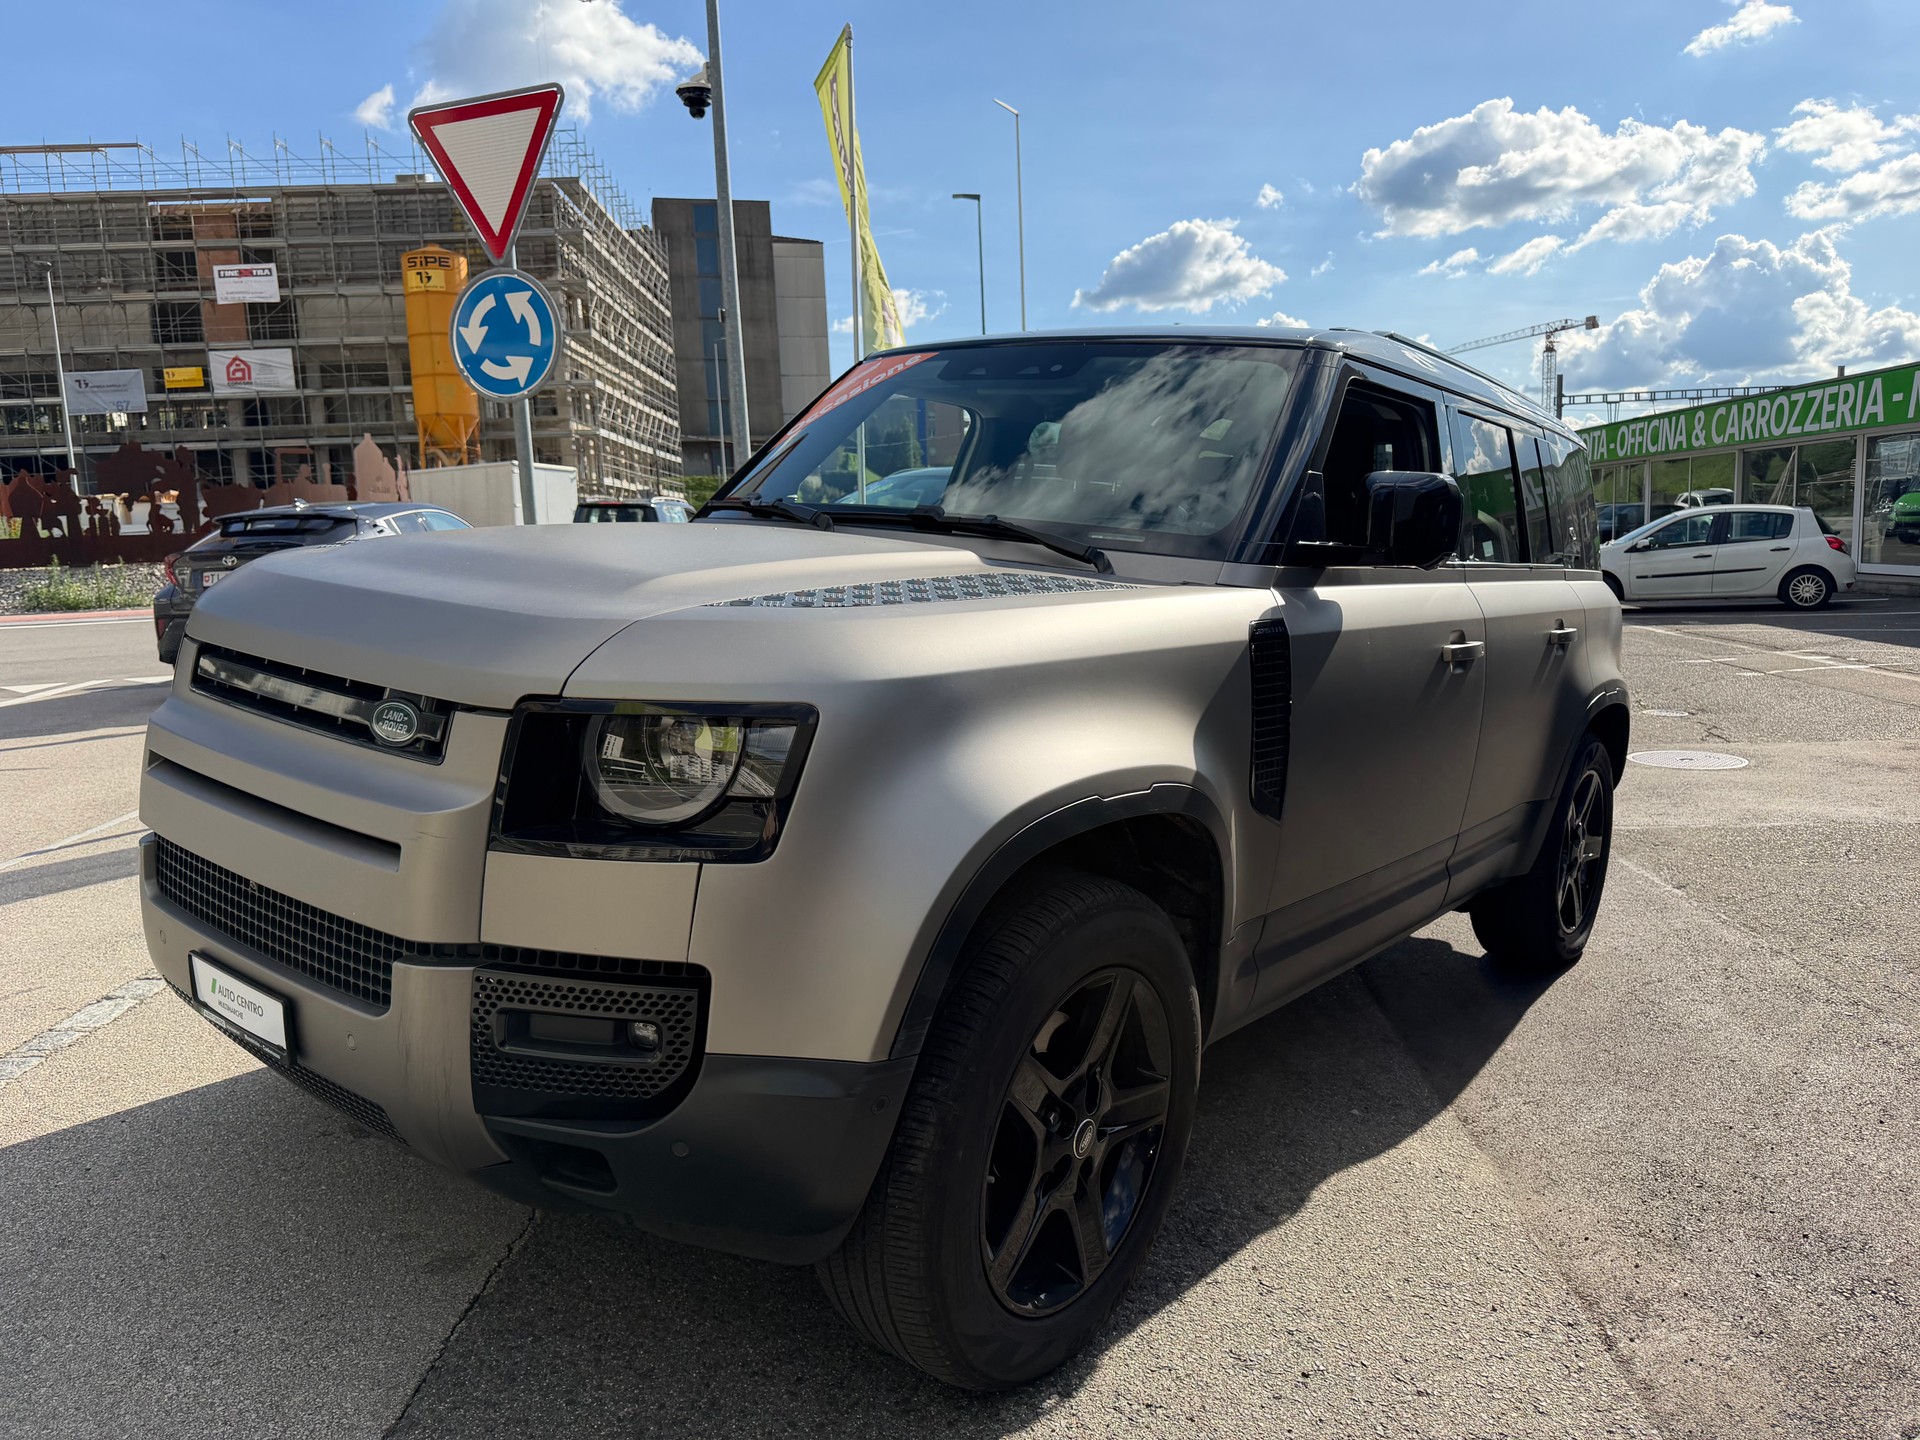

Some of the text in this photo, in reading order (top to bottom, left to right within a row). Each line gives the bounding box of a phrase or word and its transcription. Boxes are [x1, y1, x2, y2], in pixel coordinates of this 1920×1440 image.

[1616, 414, 1688, 457] OFFICINA
[1692, 410, 1706, 448] &
[1711, 377, 1884, 443] CARROZZERIA
[218, 984, 264, 1017] AUTO CENTRO
